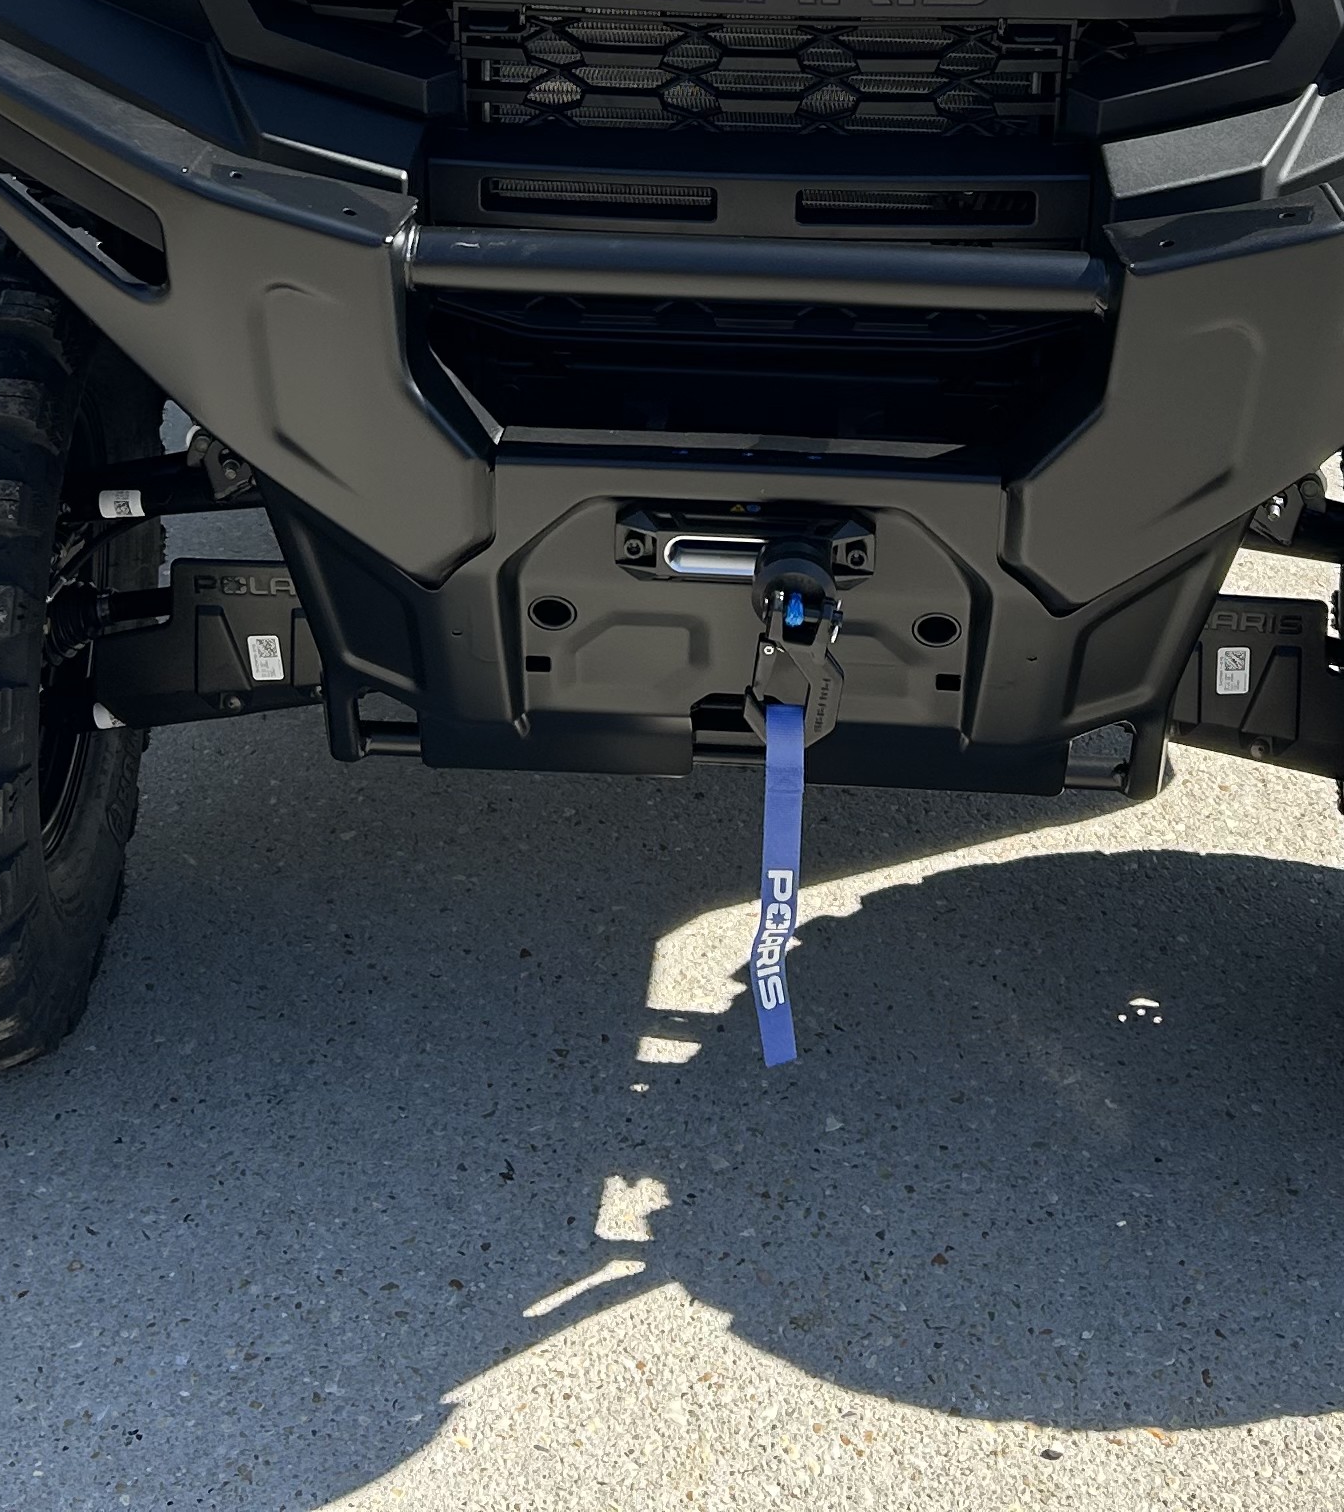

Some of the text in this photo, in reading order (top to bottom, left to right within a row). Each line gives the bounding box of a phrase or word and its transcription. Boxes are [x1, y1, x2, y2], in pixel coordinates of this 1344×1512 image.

[193, 574, 297, 596] POLA
[1205, 610, 1303, 636] ARIS
[756, 869, 794, 1011] POLARIS
